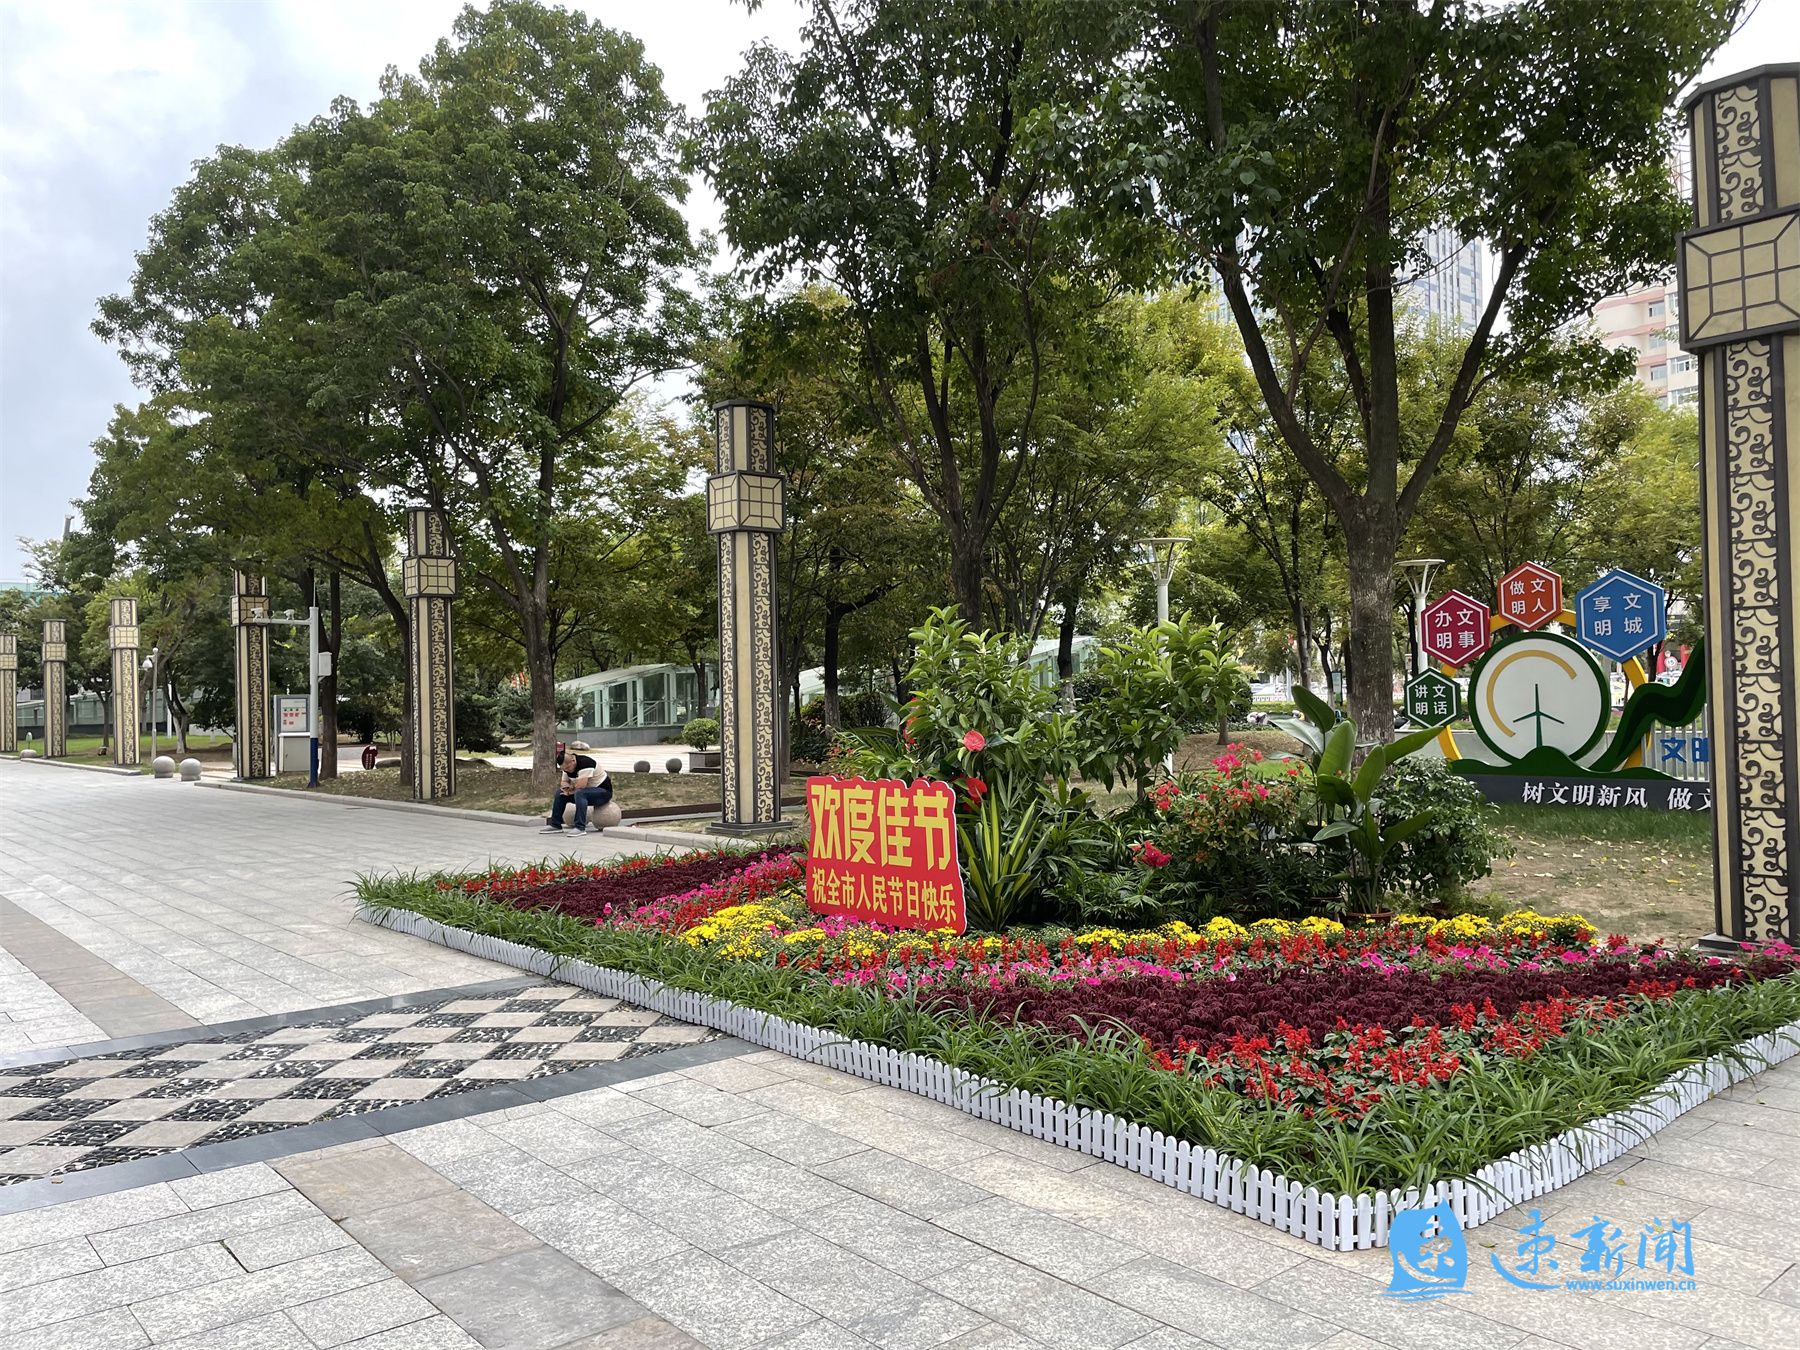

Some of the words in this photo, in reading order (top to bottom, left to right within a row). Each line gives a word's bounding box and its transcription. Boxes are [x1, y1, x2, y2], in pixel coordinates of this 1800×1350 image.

[1509, 578, 1546, 596] 做文
[1511, 598, 1547, 615] 明人
[1593, 592, 1642, 613] 享文
[1435, 608, 1474, 628] 办文
[1594, 616, 1643, 636] 明城
[1436, 630, 1475, 649] 明事
[1415, 684, 1446, 698] 讲文
[1415, 701, 1447, 715] 明话
[1522, 782, 1648, 809] 树文明新风
[811, 784, 951, 871] 欢度佳节
[812, 866, 957, 924] 祝全市人民节日快乐
